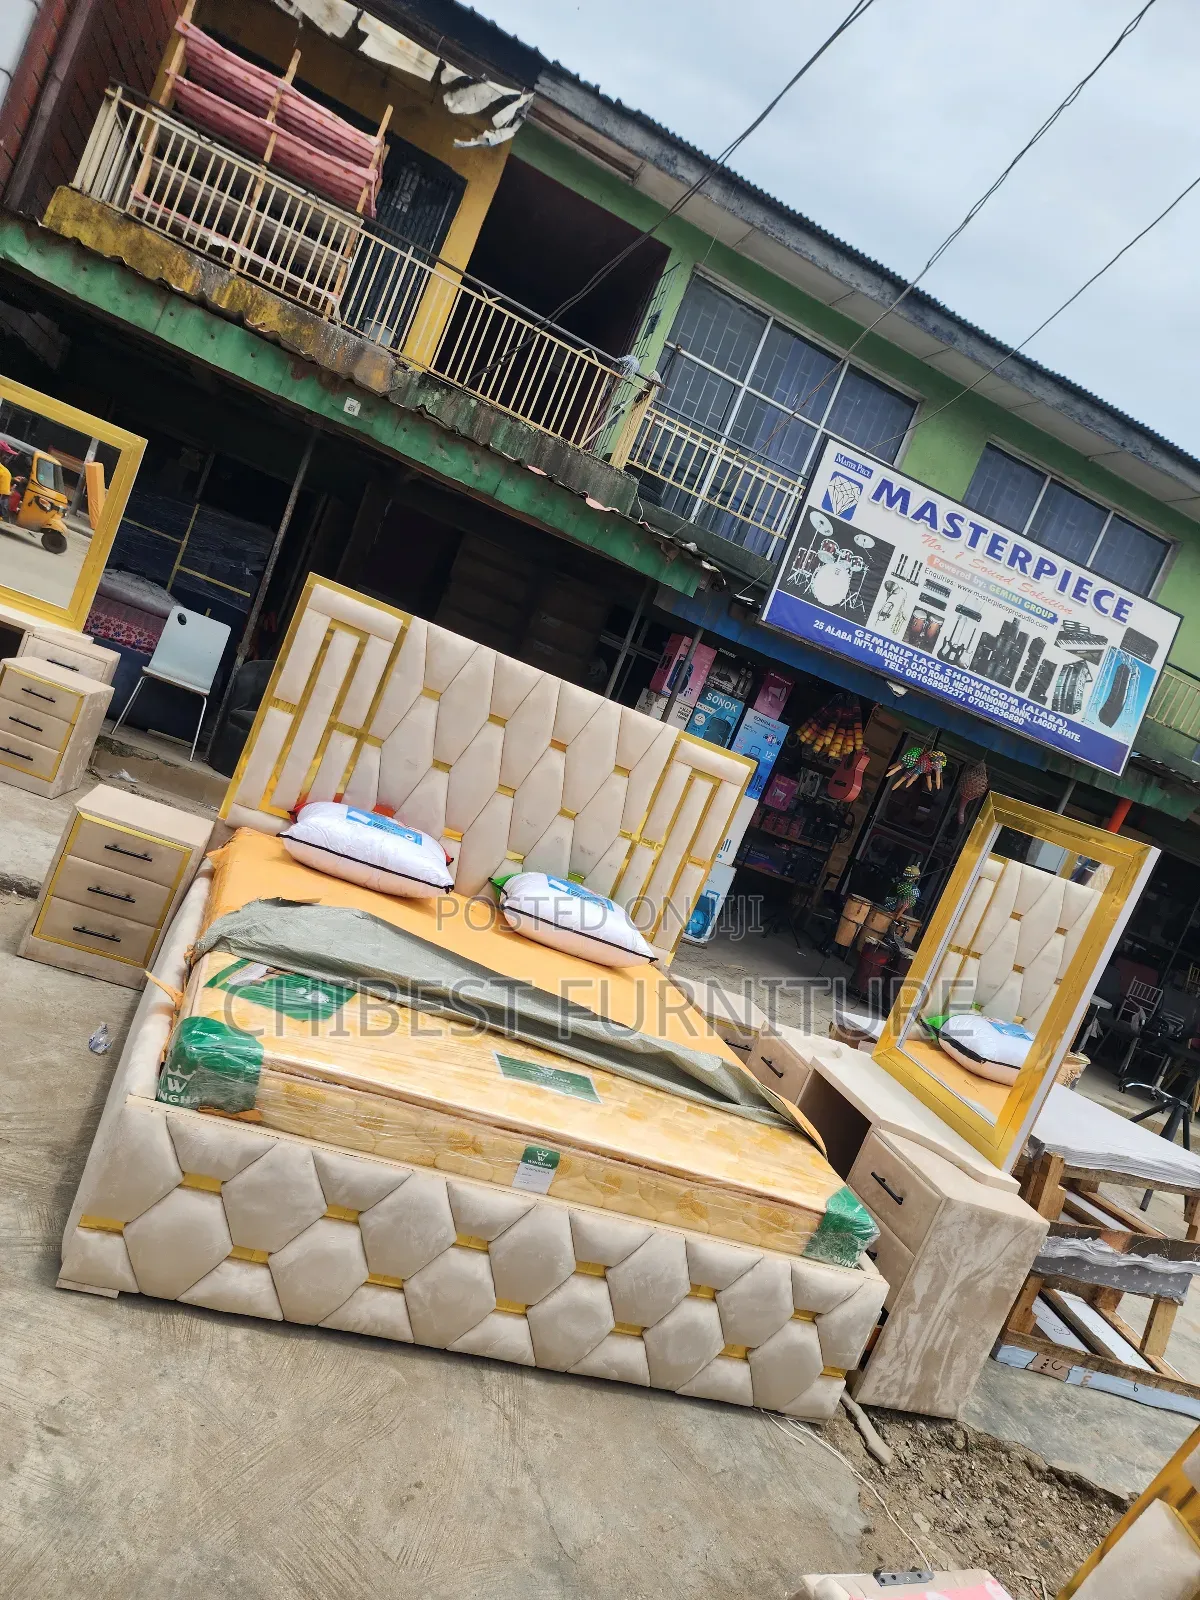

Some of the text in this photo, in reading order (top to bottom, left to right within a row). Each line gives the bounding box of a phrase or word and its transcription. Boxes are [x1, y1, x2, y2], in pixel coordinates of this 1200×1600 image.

[870, 477, 1134, 625] MASTERPIECE
[921, 533, 1073, 615] No. 1 Sound Solution
[933, 556, 1054, 620] Powered by: GEMINI GROUP
[705, 692, 738, 713] SONOK
[813, 619, 824, 630] 25
[824, 625, 852, 643] ALABA
[853, 636, 874, 652] INT'L
[875, 647, 909, 668] MARKET,
[910, 661, 928, 674] OJO
[928, 670, 950, 687] ROAD,
[952, 681, 973, 695] NEAR
[974, 687, 1009, 710] DIAMOND
[1009, 704, 1032, 722] BANK,
[1032, 716, 1057, 732] LAGOS
[854, 629, 1068, 729] GEMINIPLACE SHOWROOM (ALABA)
[883, 658, 904, 674] TEL:
[967, 695, 1025, 726] 07032636890
